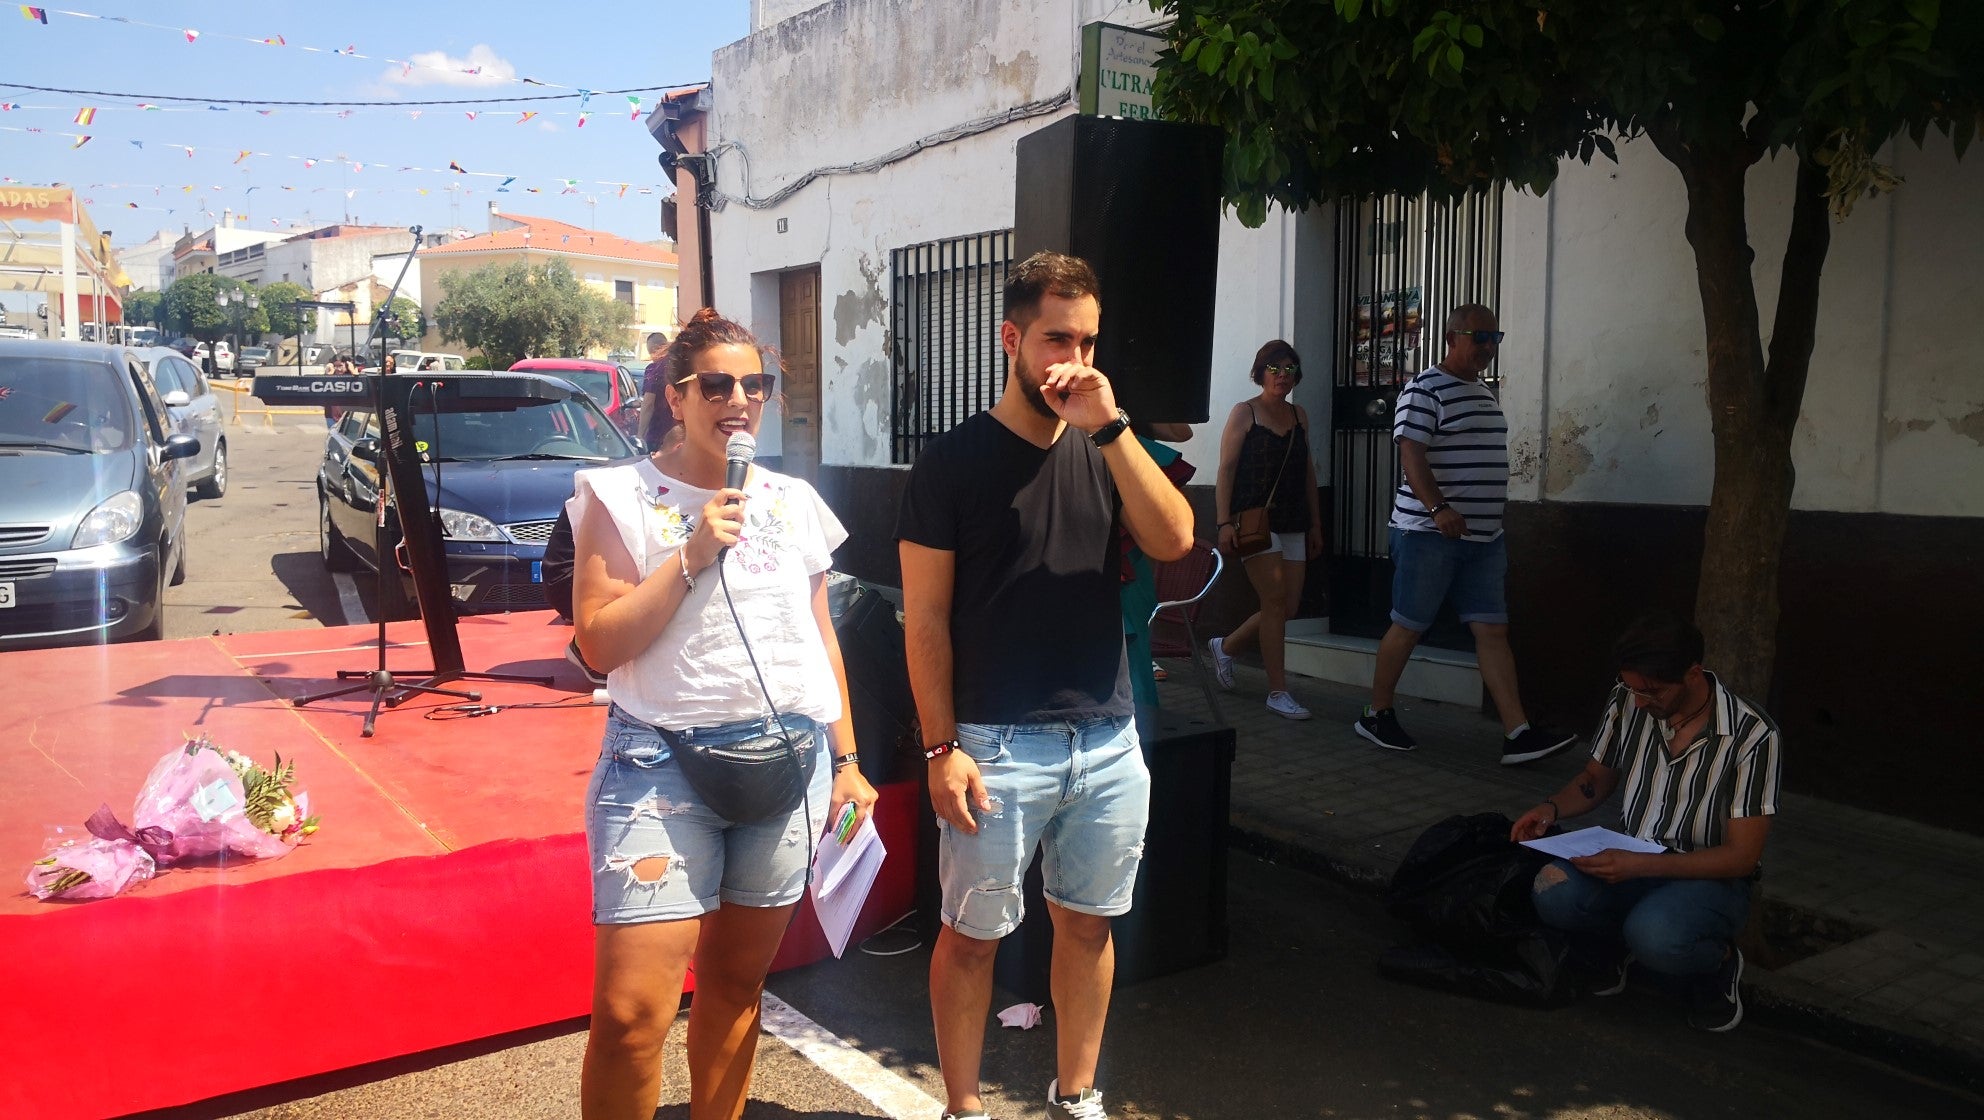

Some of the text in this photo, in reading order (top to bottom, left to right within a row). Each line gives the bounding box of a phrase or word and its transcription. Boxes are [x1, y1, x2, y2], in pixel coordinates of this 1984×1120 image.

[311, 381, 363, 393] CASIO
[384, 407, 398, 433] adam
[389, 431, 403, 450] hall
